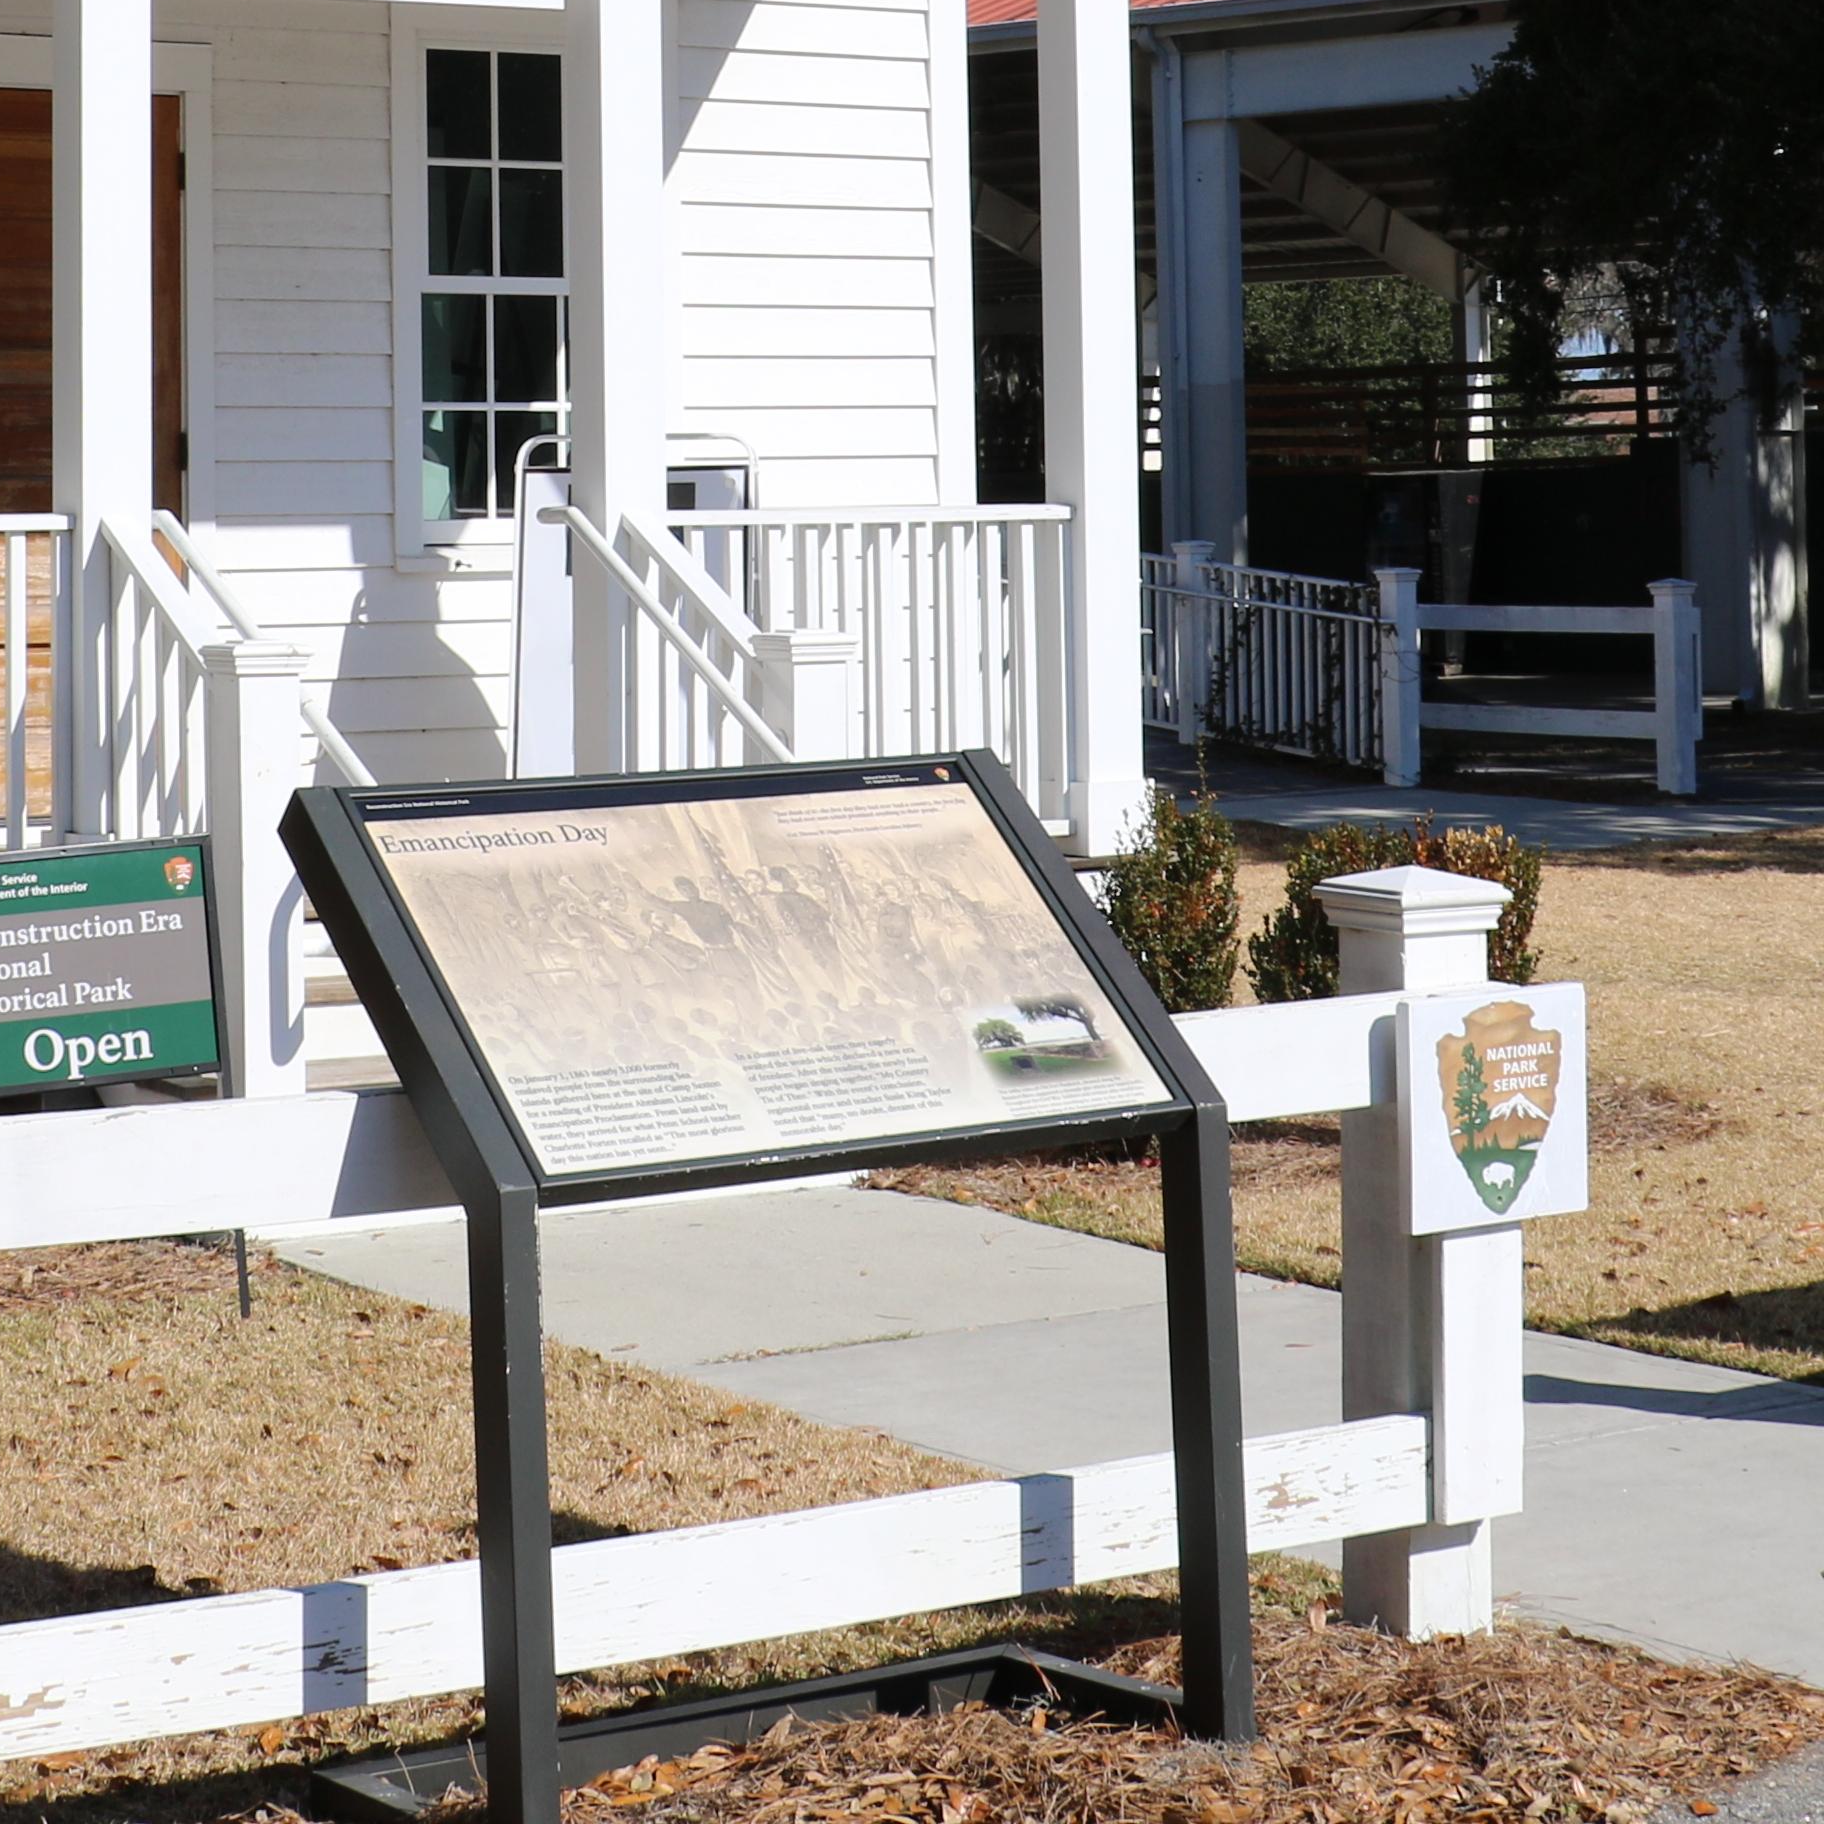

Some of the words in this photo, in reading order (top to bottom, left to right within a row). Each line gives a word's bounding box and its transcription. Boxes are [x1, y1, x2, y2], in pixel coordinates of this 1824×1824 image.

[378, 826, 555, 855] Emancipation
[558, 824, 608, 845] Day
[2, 873, 37, 886] Service
[17, 887, 30, 897] of
[32, 885, 48, 896] the
[50, 881, 88, 894] Interior
[139, 910, 183, 933] Era
[74, 977, 133, 1005] Park
[23, 1028, 154, 1080] Open
[1486, 1041, 1554, 1061] NATIONAL
[1503, 1060, 1538, 1075] PARK
[1493, 1074, 1548, 1093] SERVICE
